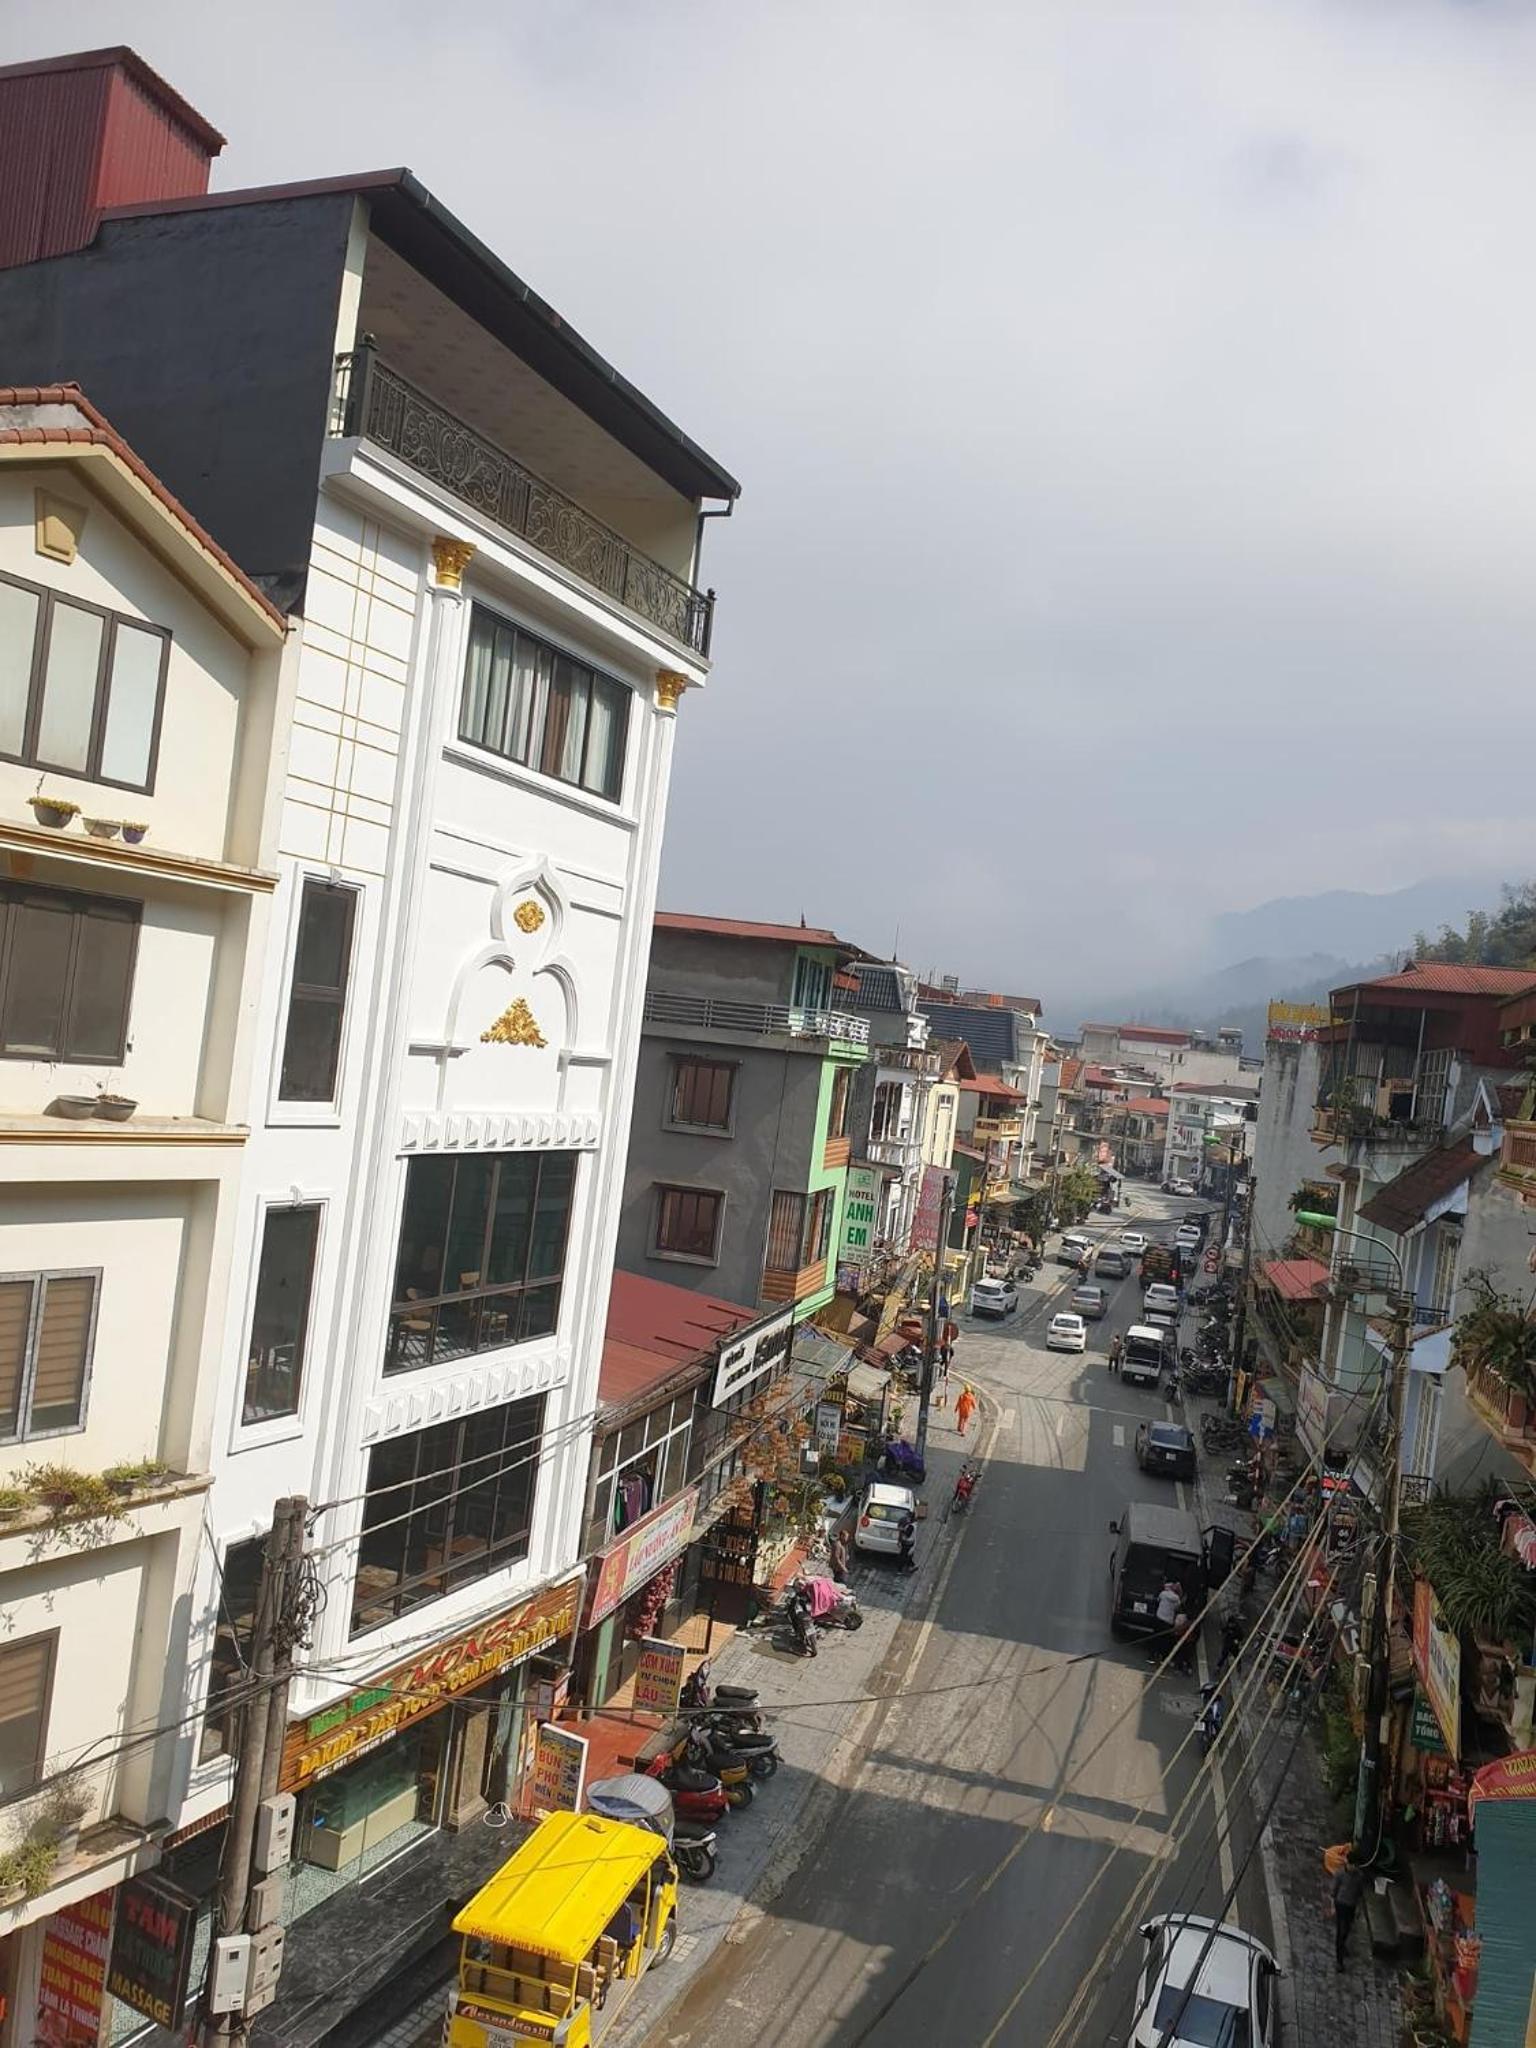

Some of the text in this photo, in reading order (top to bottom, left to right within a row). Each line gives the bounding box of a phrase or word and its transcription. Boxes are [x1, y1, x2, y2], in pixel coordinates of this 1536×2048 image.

[848, 1189, 875, 1201] HOTEL
[846, 1201, 875, 1223] ANH
[846, 1226, 868, 1247] EM
[368, 1702, 404, 1738] FAST
[111, 1971, 172, 2024] MASSAGE
